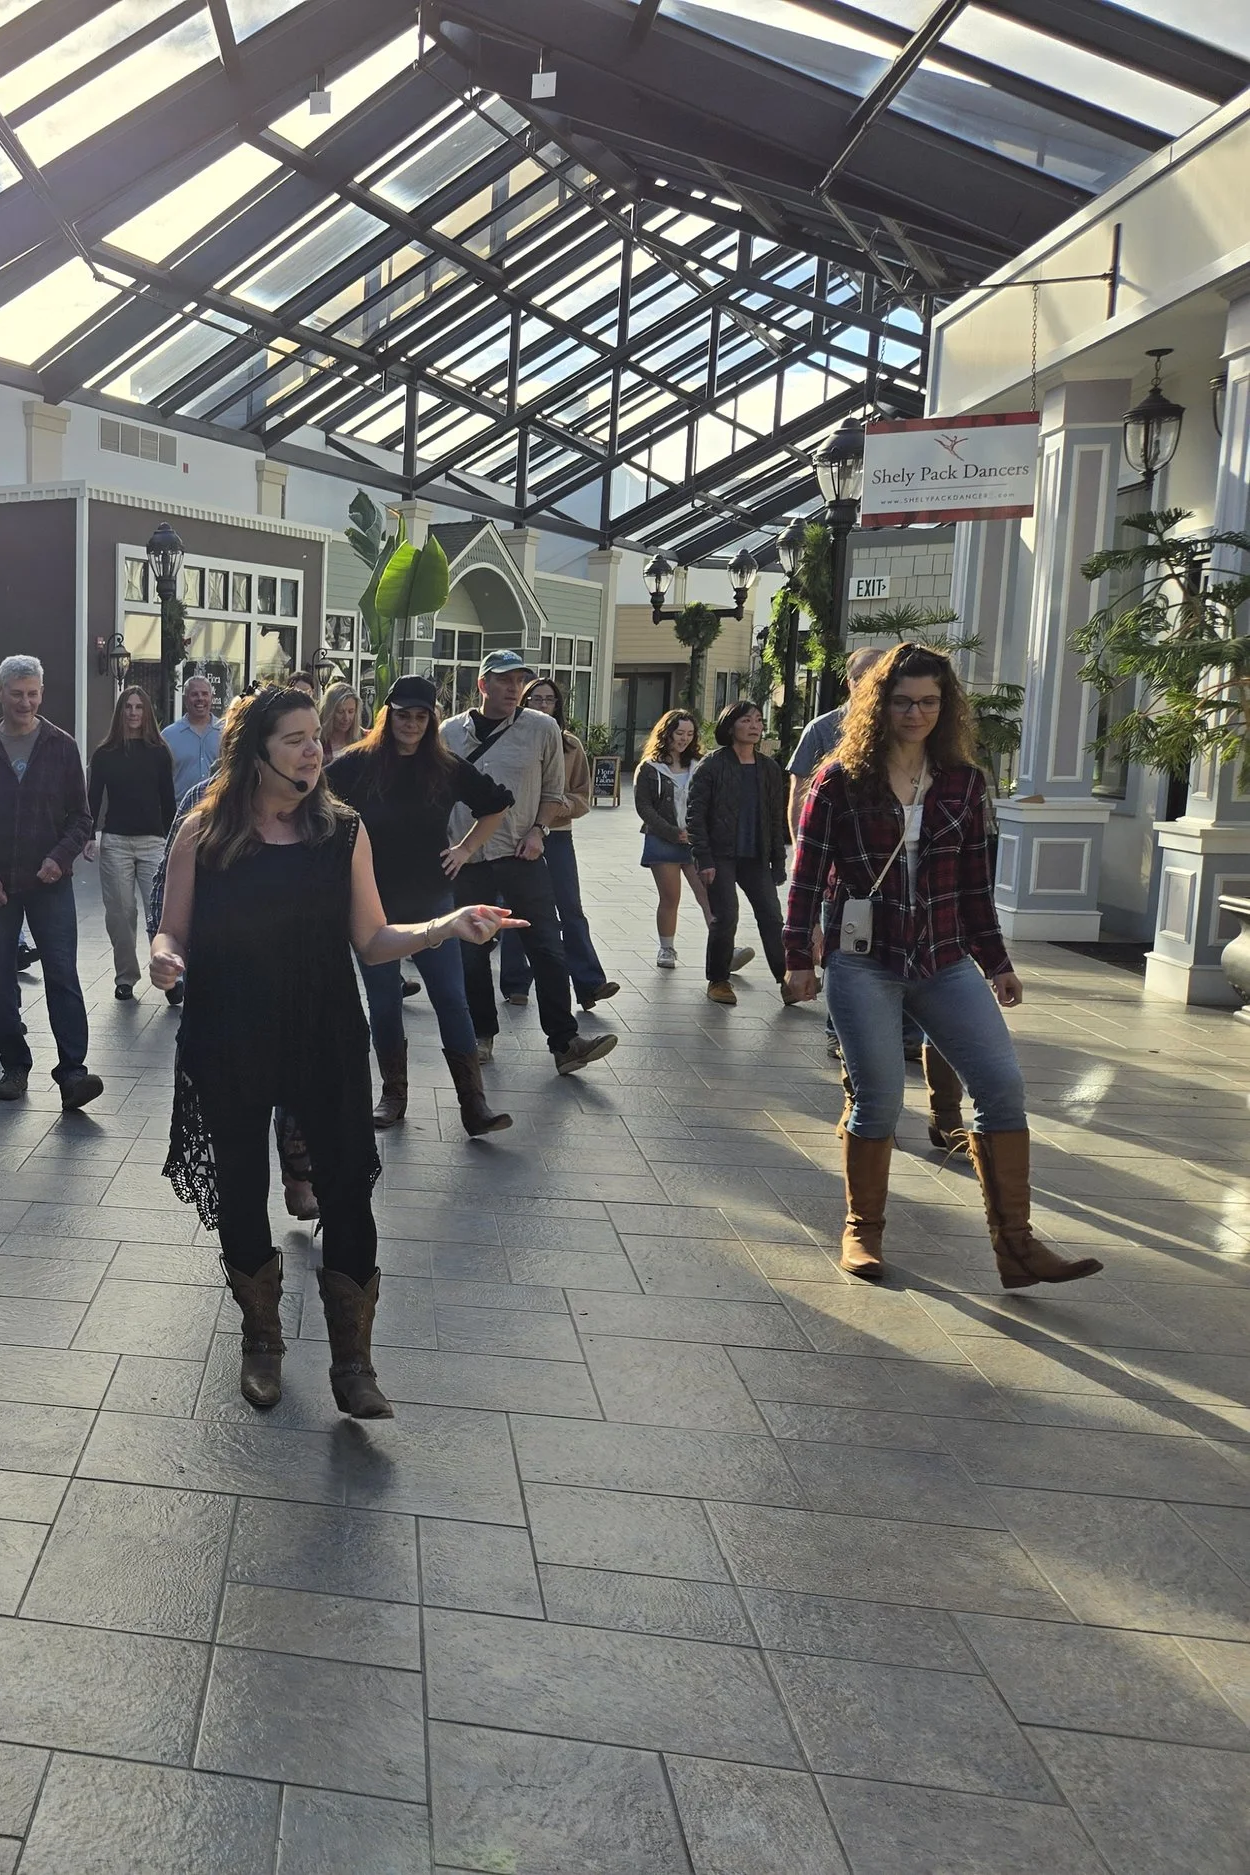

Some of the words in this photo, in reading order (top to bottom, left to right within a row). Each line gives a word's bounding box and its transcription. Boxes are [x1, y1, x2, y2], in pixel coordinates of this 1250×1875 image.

[871, 467, 915, 487] Shely
[920, 465, 958, 482] Pack
[962, 463, 1029, 479] Dancers
[880, 492, 1015, 505] www.SHELYPACKDANCER.com
[856, 579, 884, 597] EXIT
